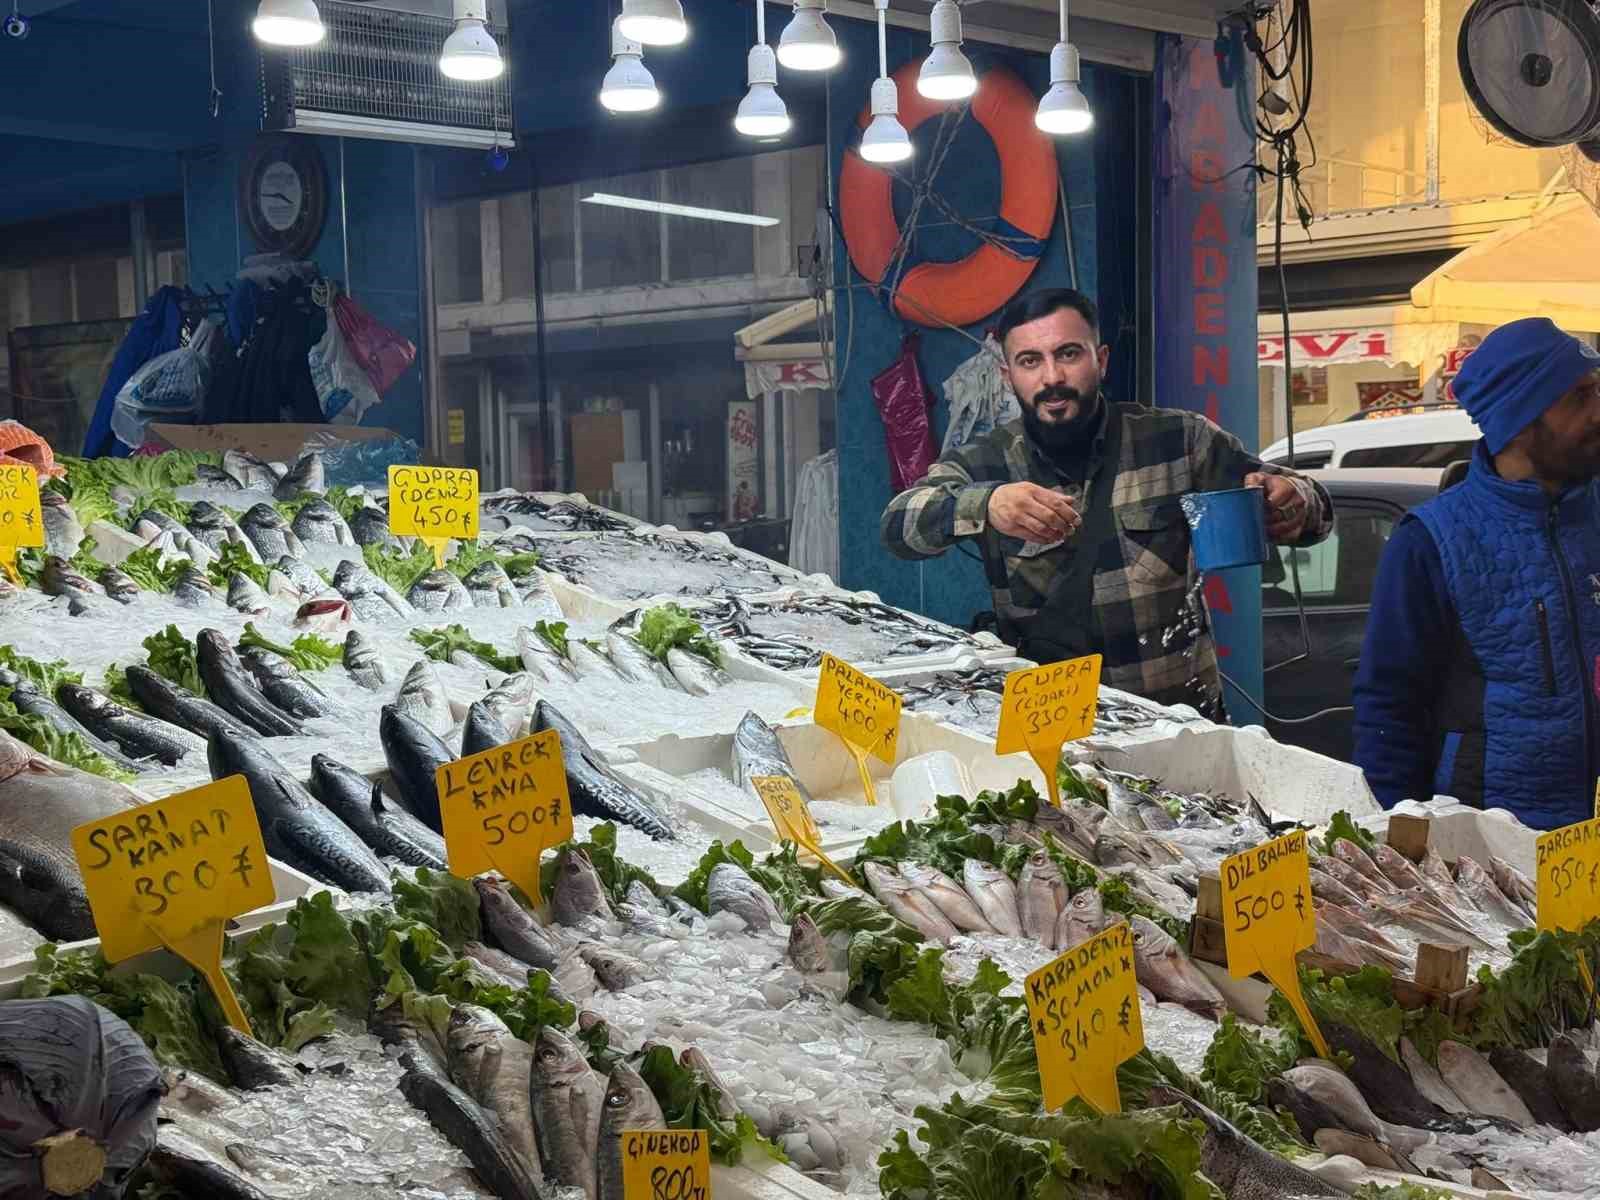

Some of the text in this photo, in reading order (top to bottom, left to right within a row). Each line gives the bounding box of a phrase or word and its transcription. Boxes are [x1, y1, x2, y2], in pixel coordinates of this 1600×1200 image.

[445, 738, 551, 798] LEVREK
[472, 773, 537, 811] KAYA
[88, 809, 169, 870] SARI
[128, 808, 232, 870] KANAT
